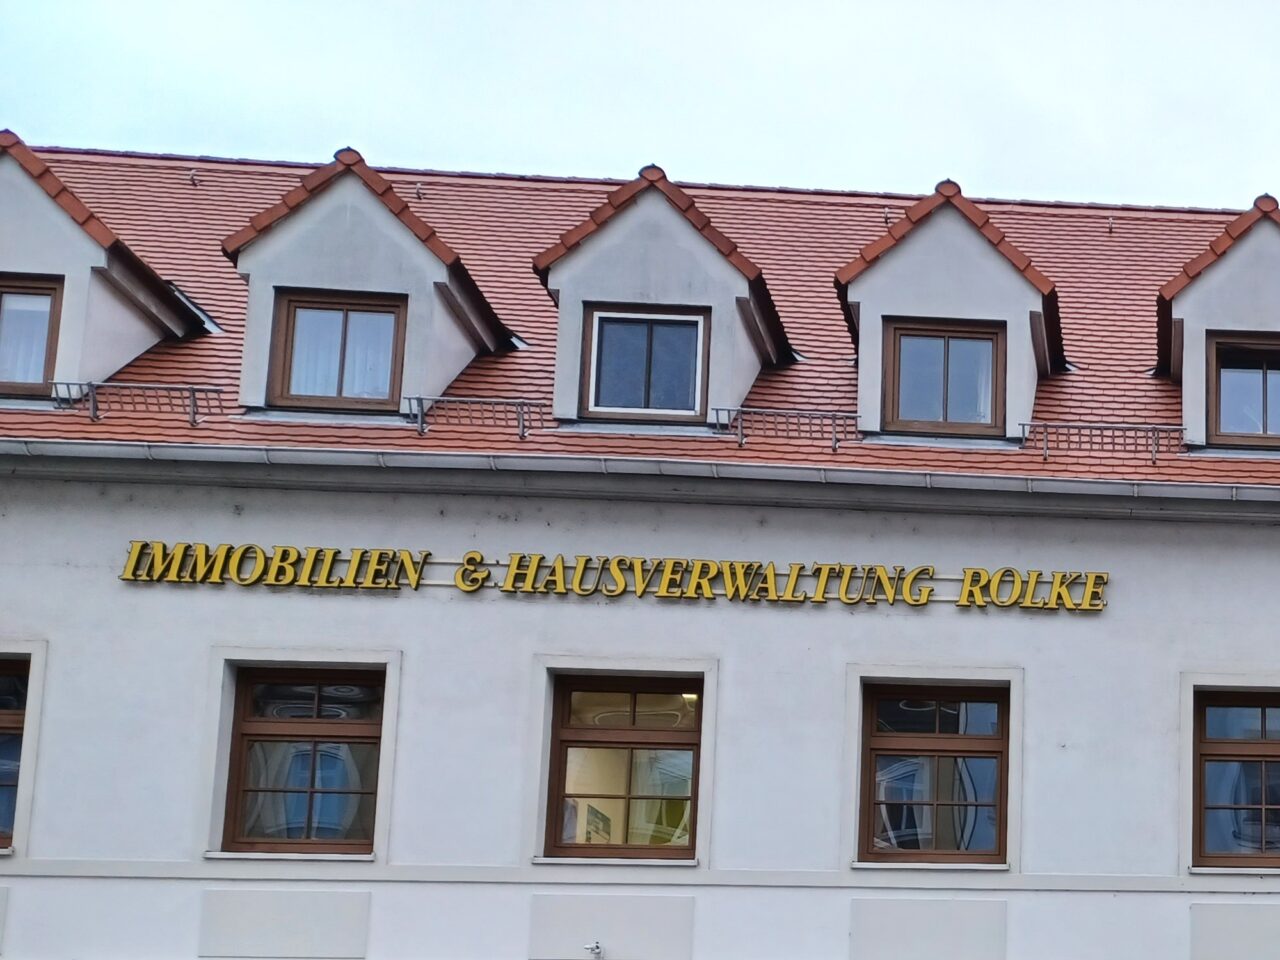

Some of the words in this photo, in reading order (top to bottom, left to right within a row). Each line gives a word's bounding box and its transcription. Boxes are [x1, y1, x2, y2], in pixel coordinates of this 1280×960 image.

[120, 540, 431, 591] IMMOBILIEN
[454, 550, 491, 593] &
[500, 553, 934, 607] HAUSVERWALTUNG
[956, 566, 1108, 612] ROLKE
